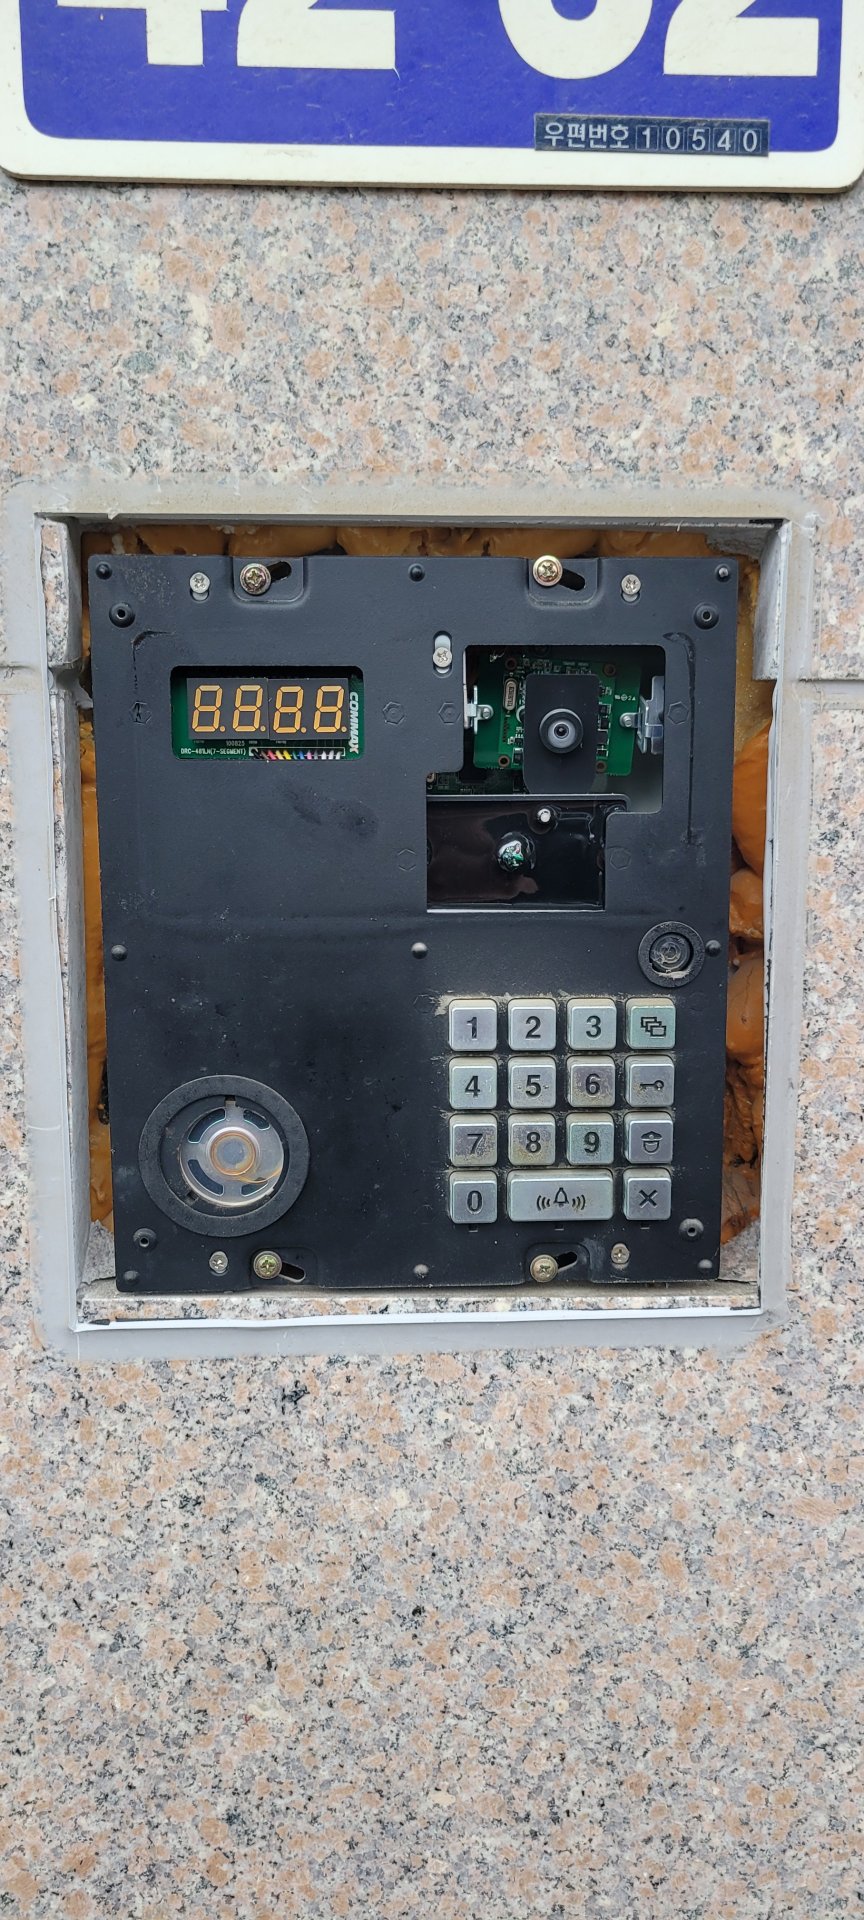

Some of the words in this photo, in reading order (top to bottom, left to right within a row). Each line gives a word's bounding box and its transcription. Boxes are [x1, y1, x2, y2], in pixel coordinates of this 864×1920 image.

[544, 121, 630, 149] 우편번호
[641, 126, 758, 152] 10540
[348, 691, 360, 755] COMMAX
[466, 1016, 478, 1040] 1
[525, 1015, 542, 1039] 2
[585, 1015, 602, 1038] 3
[464, 1075, 481, 1098] 4
[525, 1074, 542, 1098] 5
[585, 1073, 601, 1096] 6
[467, 1133, 484, 1154] 7
[525, 1131, 542, 1154] 8
[584, 1131, 601, 1154] 9
[466, 1190, 483, 1213] 0
